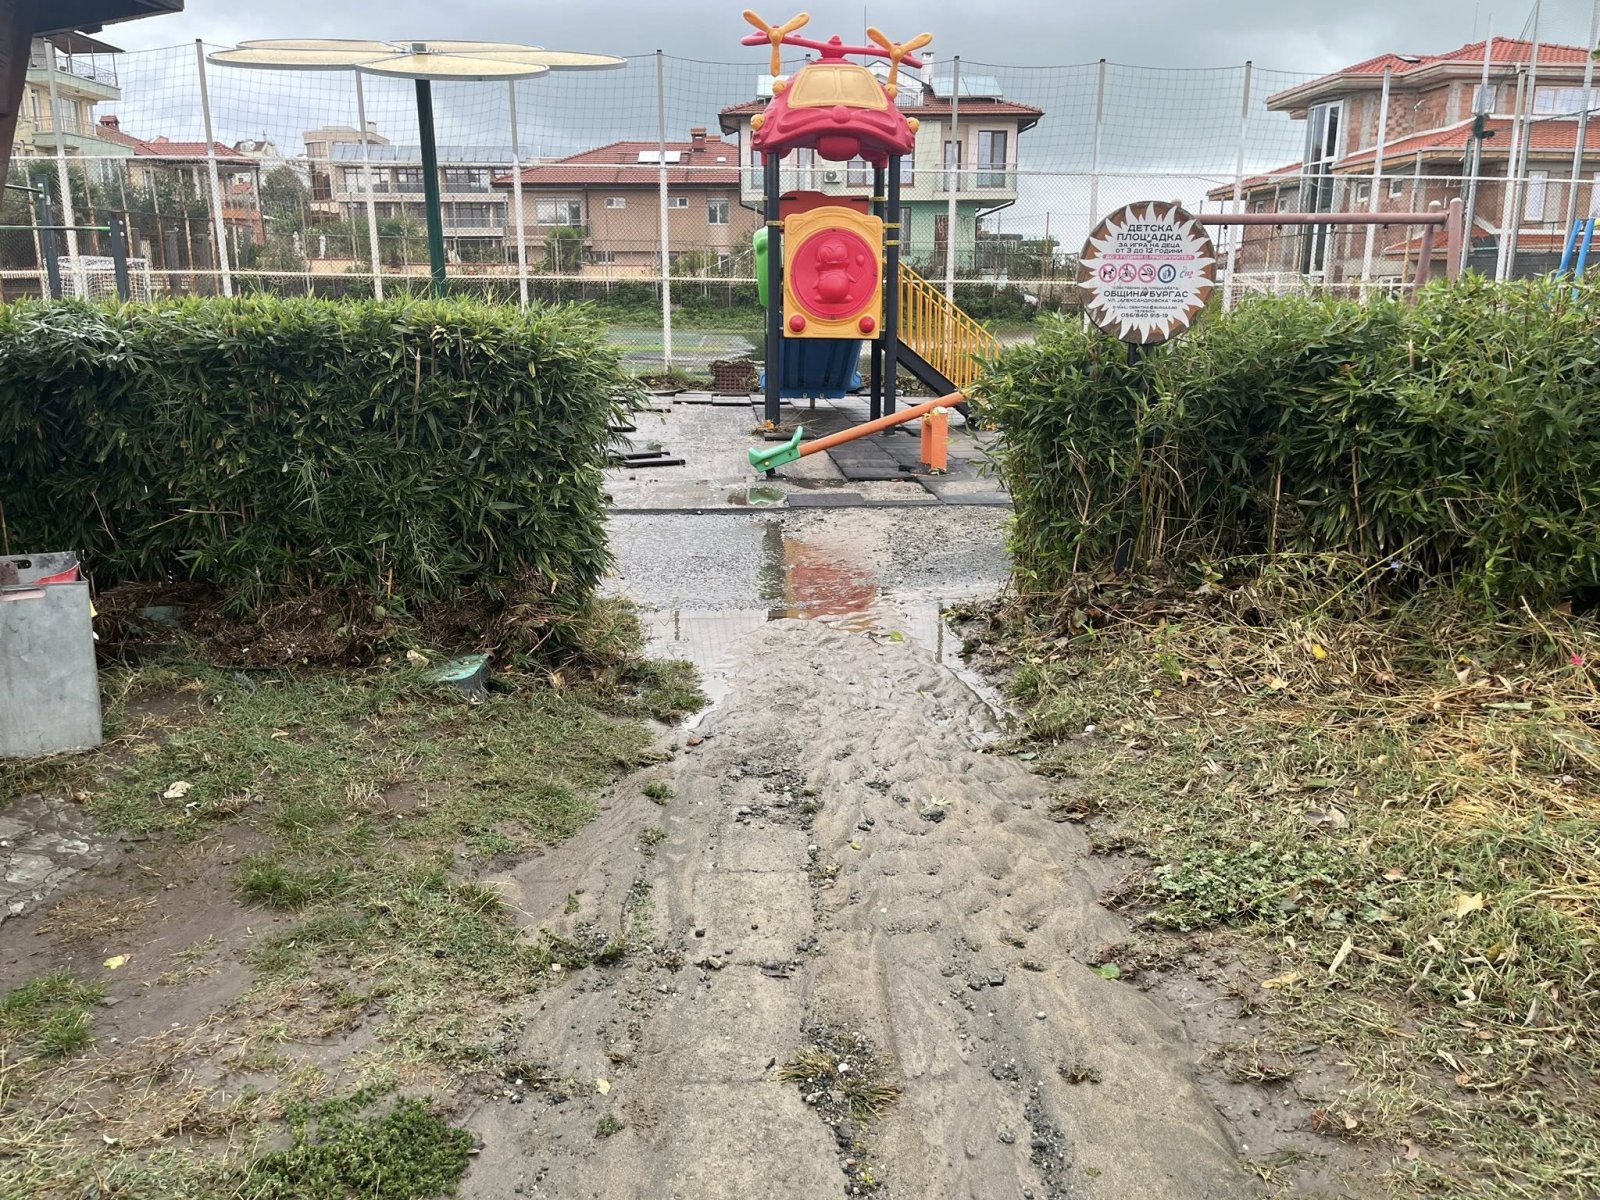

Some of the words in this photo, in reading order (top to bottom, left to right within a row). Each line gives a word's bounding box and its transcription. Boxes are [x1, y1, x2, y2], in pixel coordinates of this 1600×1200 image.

[1127, 224, 1173, 232] ДЕТСКА
[1117, 233, 1182, 241] ПЛОЩАДКА
[1103, 290, 1148, 298] ОБЩИНА
[1149, 290, 1189, 298] БУРГАС
